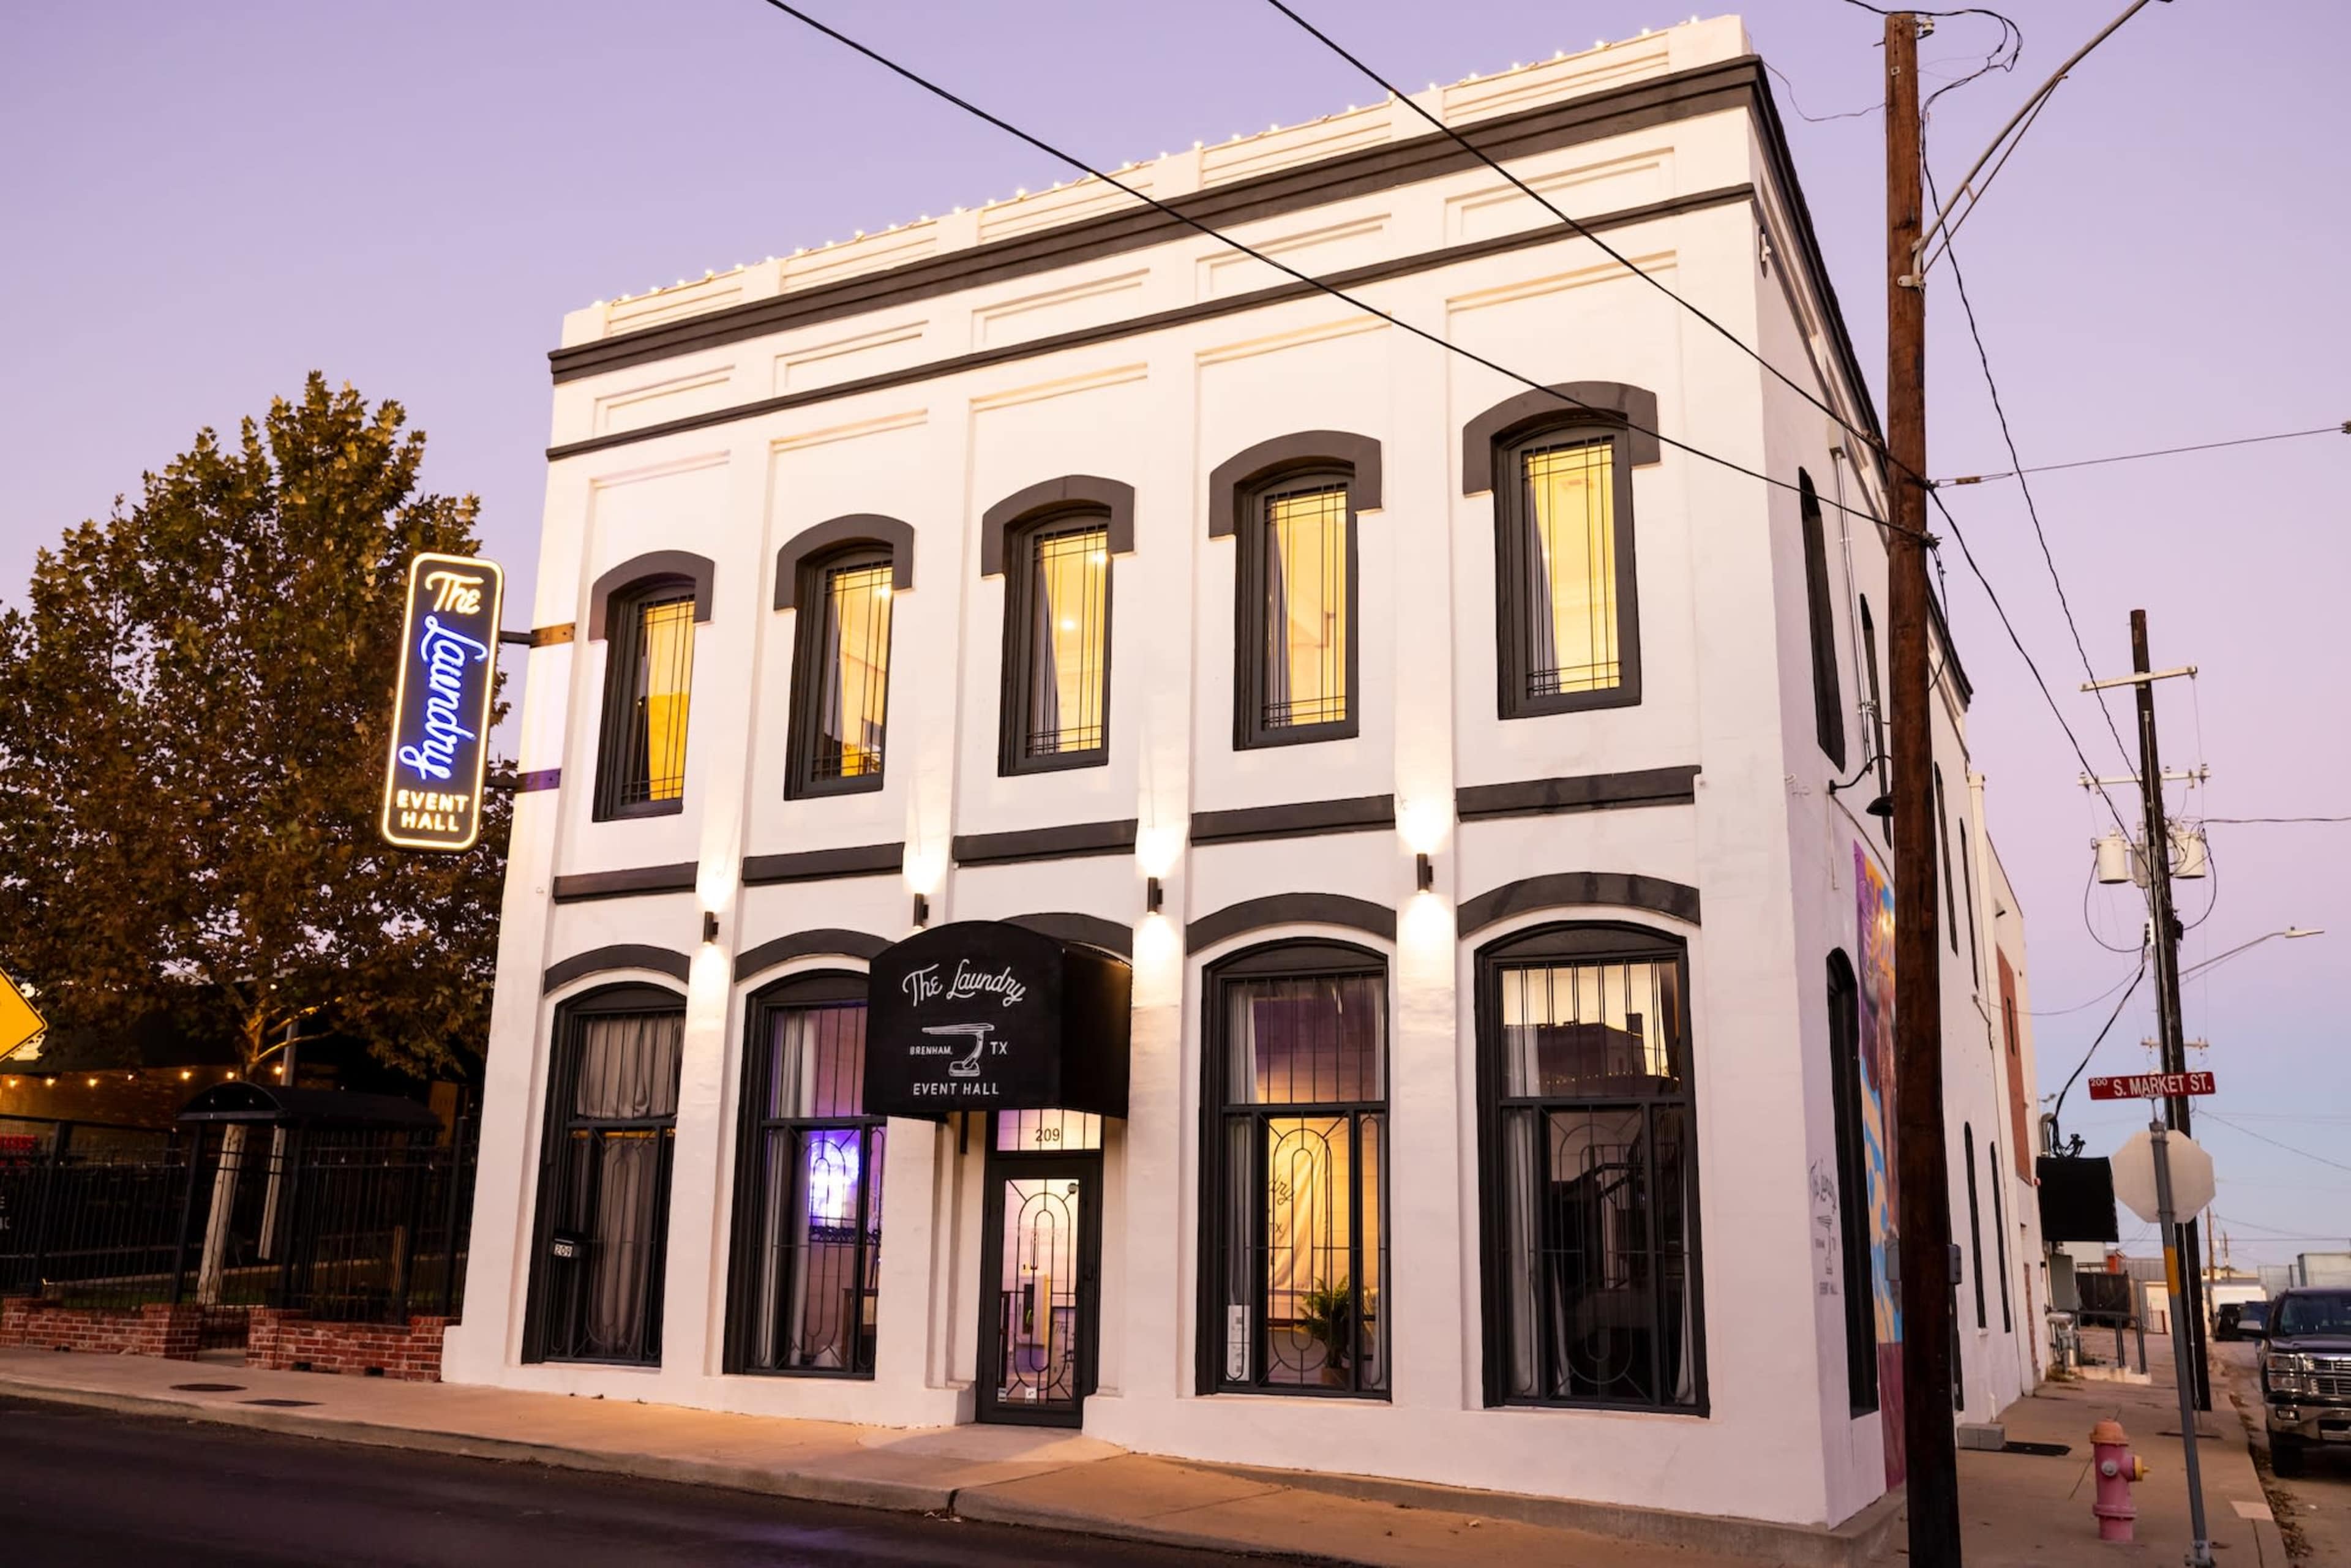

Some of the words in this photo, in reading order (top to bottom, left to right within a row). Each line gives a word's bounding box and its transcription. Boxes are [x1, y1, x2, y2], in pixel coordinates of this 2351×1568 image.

[425, 571, 484, 615] The
[399, 615, 488, 781] Laundry
[396, 790, 468, 812] EVENT
[401, 811, 460, 831] HALL
[902, 963, 943, 1007] The
[946, 959, 1026, 1007] Laundry
[990, 1041, 1008, 1054] TX
[913, 1083, 956, 1095] EVENT
[962, 1082, 999, 1095] HALL
[2113, 1079, 2126, 1097] S.
[2129, 1075, 2184, 1095] MARKET
[2190, 1074, 2211, 1091] ST.
[1035, 1128, 1060, 1142] 209
[556, 1245, 571, 1256] 209
